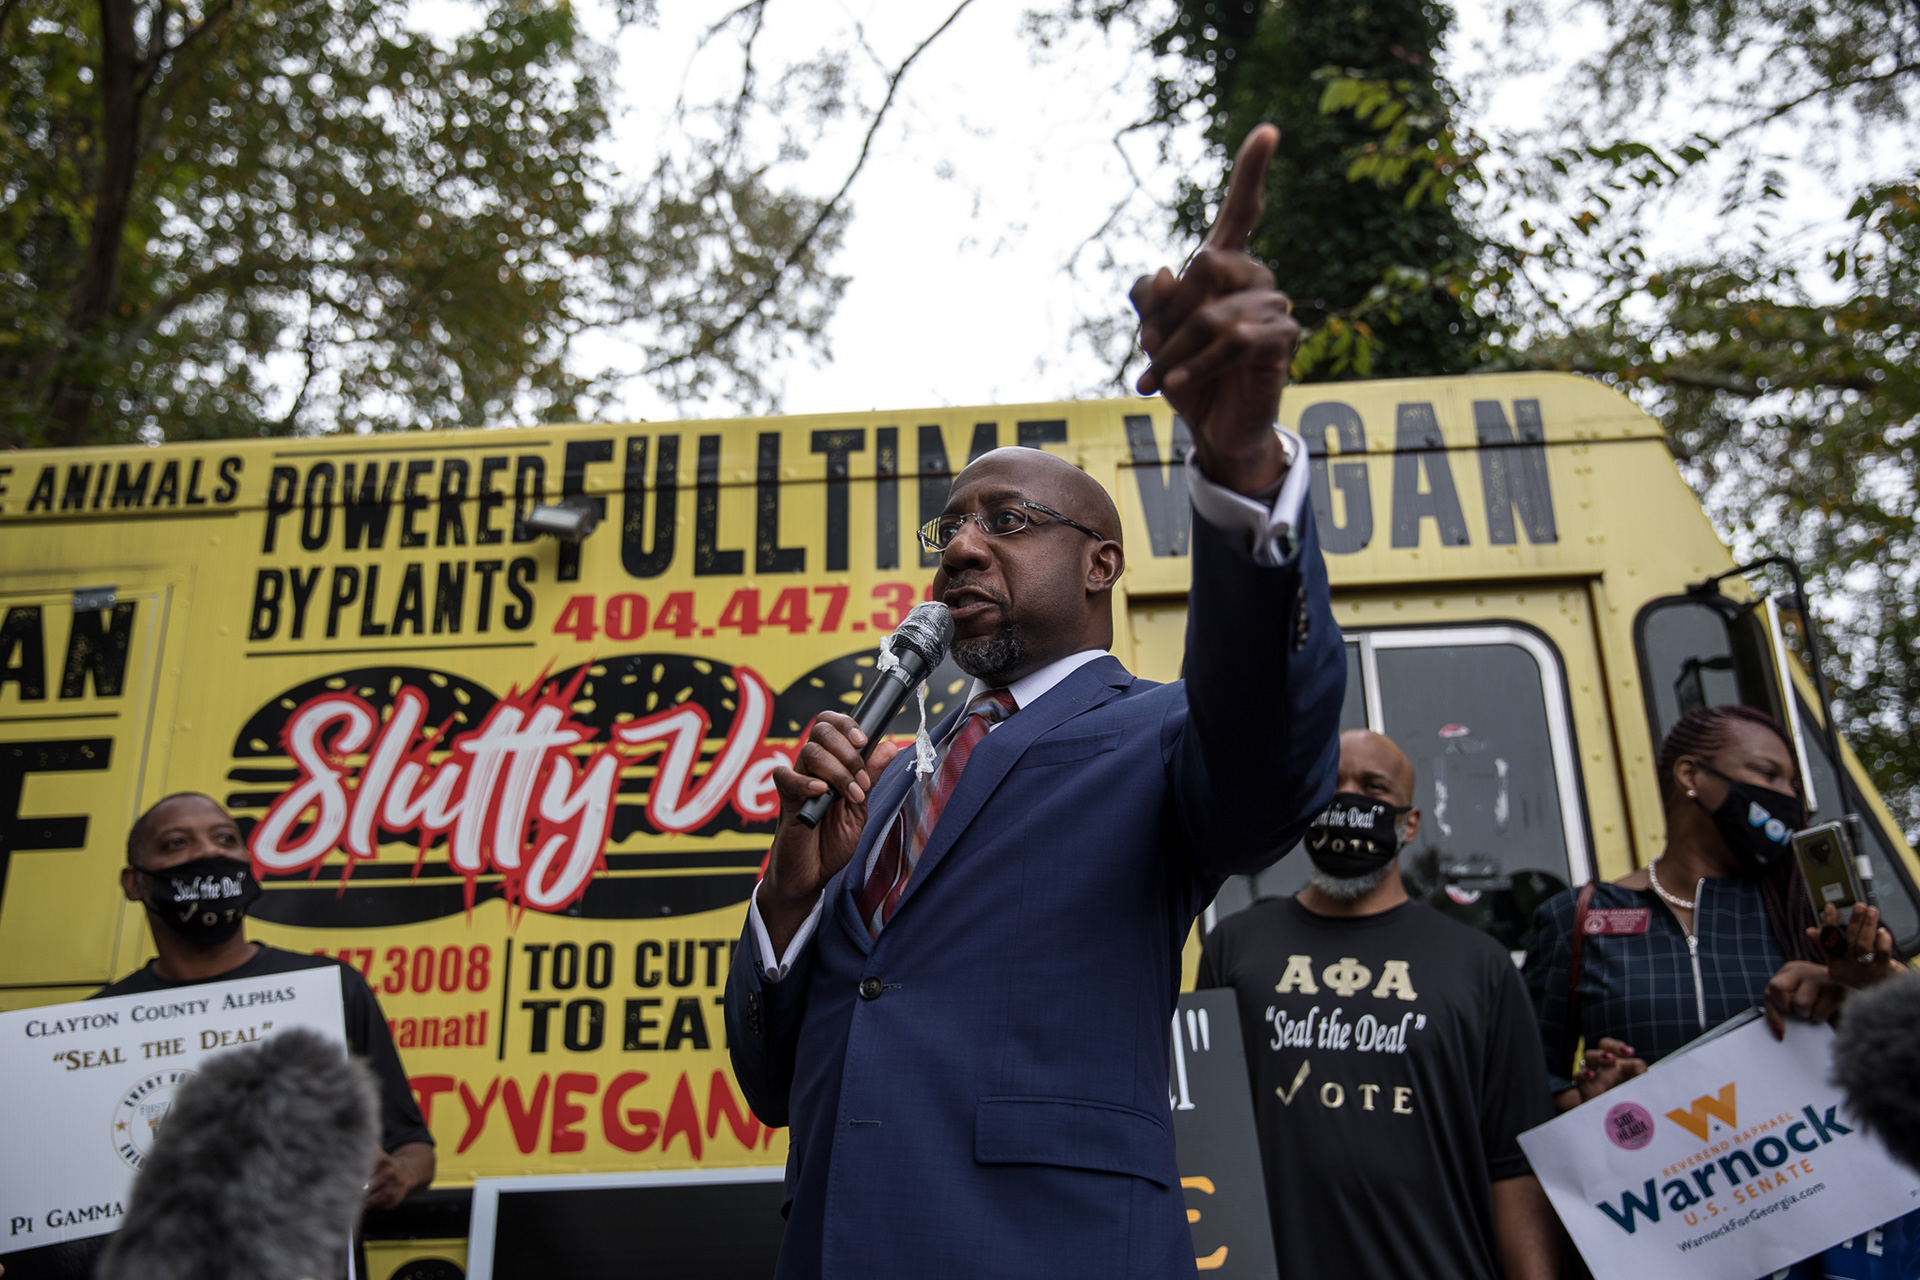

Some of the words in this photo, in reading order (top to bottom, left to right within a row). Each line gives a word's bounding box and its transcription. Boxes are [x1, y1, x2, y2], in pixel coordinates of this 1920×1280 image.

[27, 456, 244, 513] ANIMALS
[263, 455, 547, 554] POWERED
[557, 420, 1067, 581] FULLTIM
[1124, 398, 1559, 557] VGAN
[249, 566, 321, 642] BY
[326, 556, 537, 638] PLANTS
[249, 686, 625, 911] Slutty
[522, 940, 614, 991] TOO
[635, 939, 743, 989] CUT
[140, 1038, 187, 1060] THE
[521, 997, 605, 1055] TO
[623, 996, 731, 1052] EA
[1318, 1007, 1352, 1051] the
[1596, 1104, 1854, 1234] Warnock
[1661, 1141, 1730, 1178] REVEREND
[1733, 1111, 1794, 1144] RAPHAEL
[1676, 1180, 1826, 1254] WarnockForGeorgia.com
[1683, 1201, 1727, 1227] U.S.
[1732, 1157, 1815, 1205] SENATE
